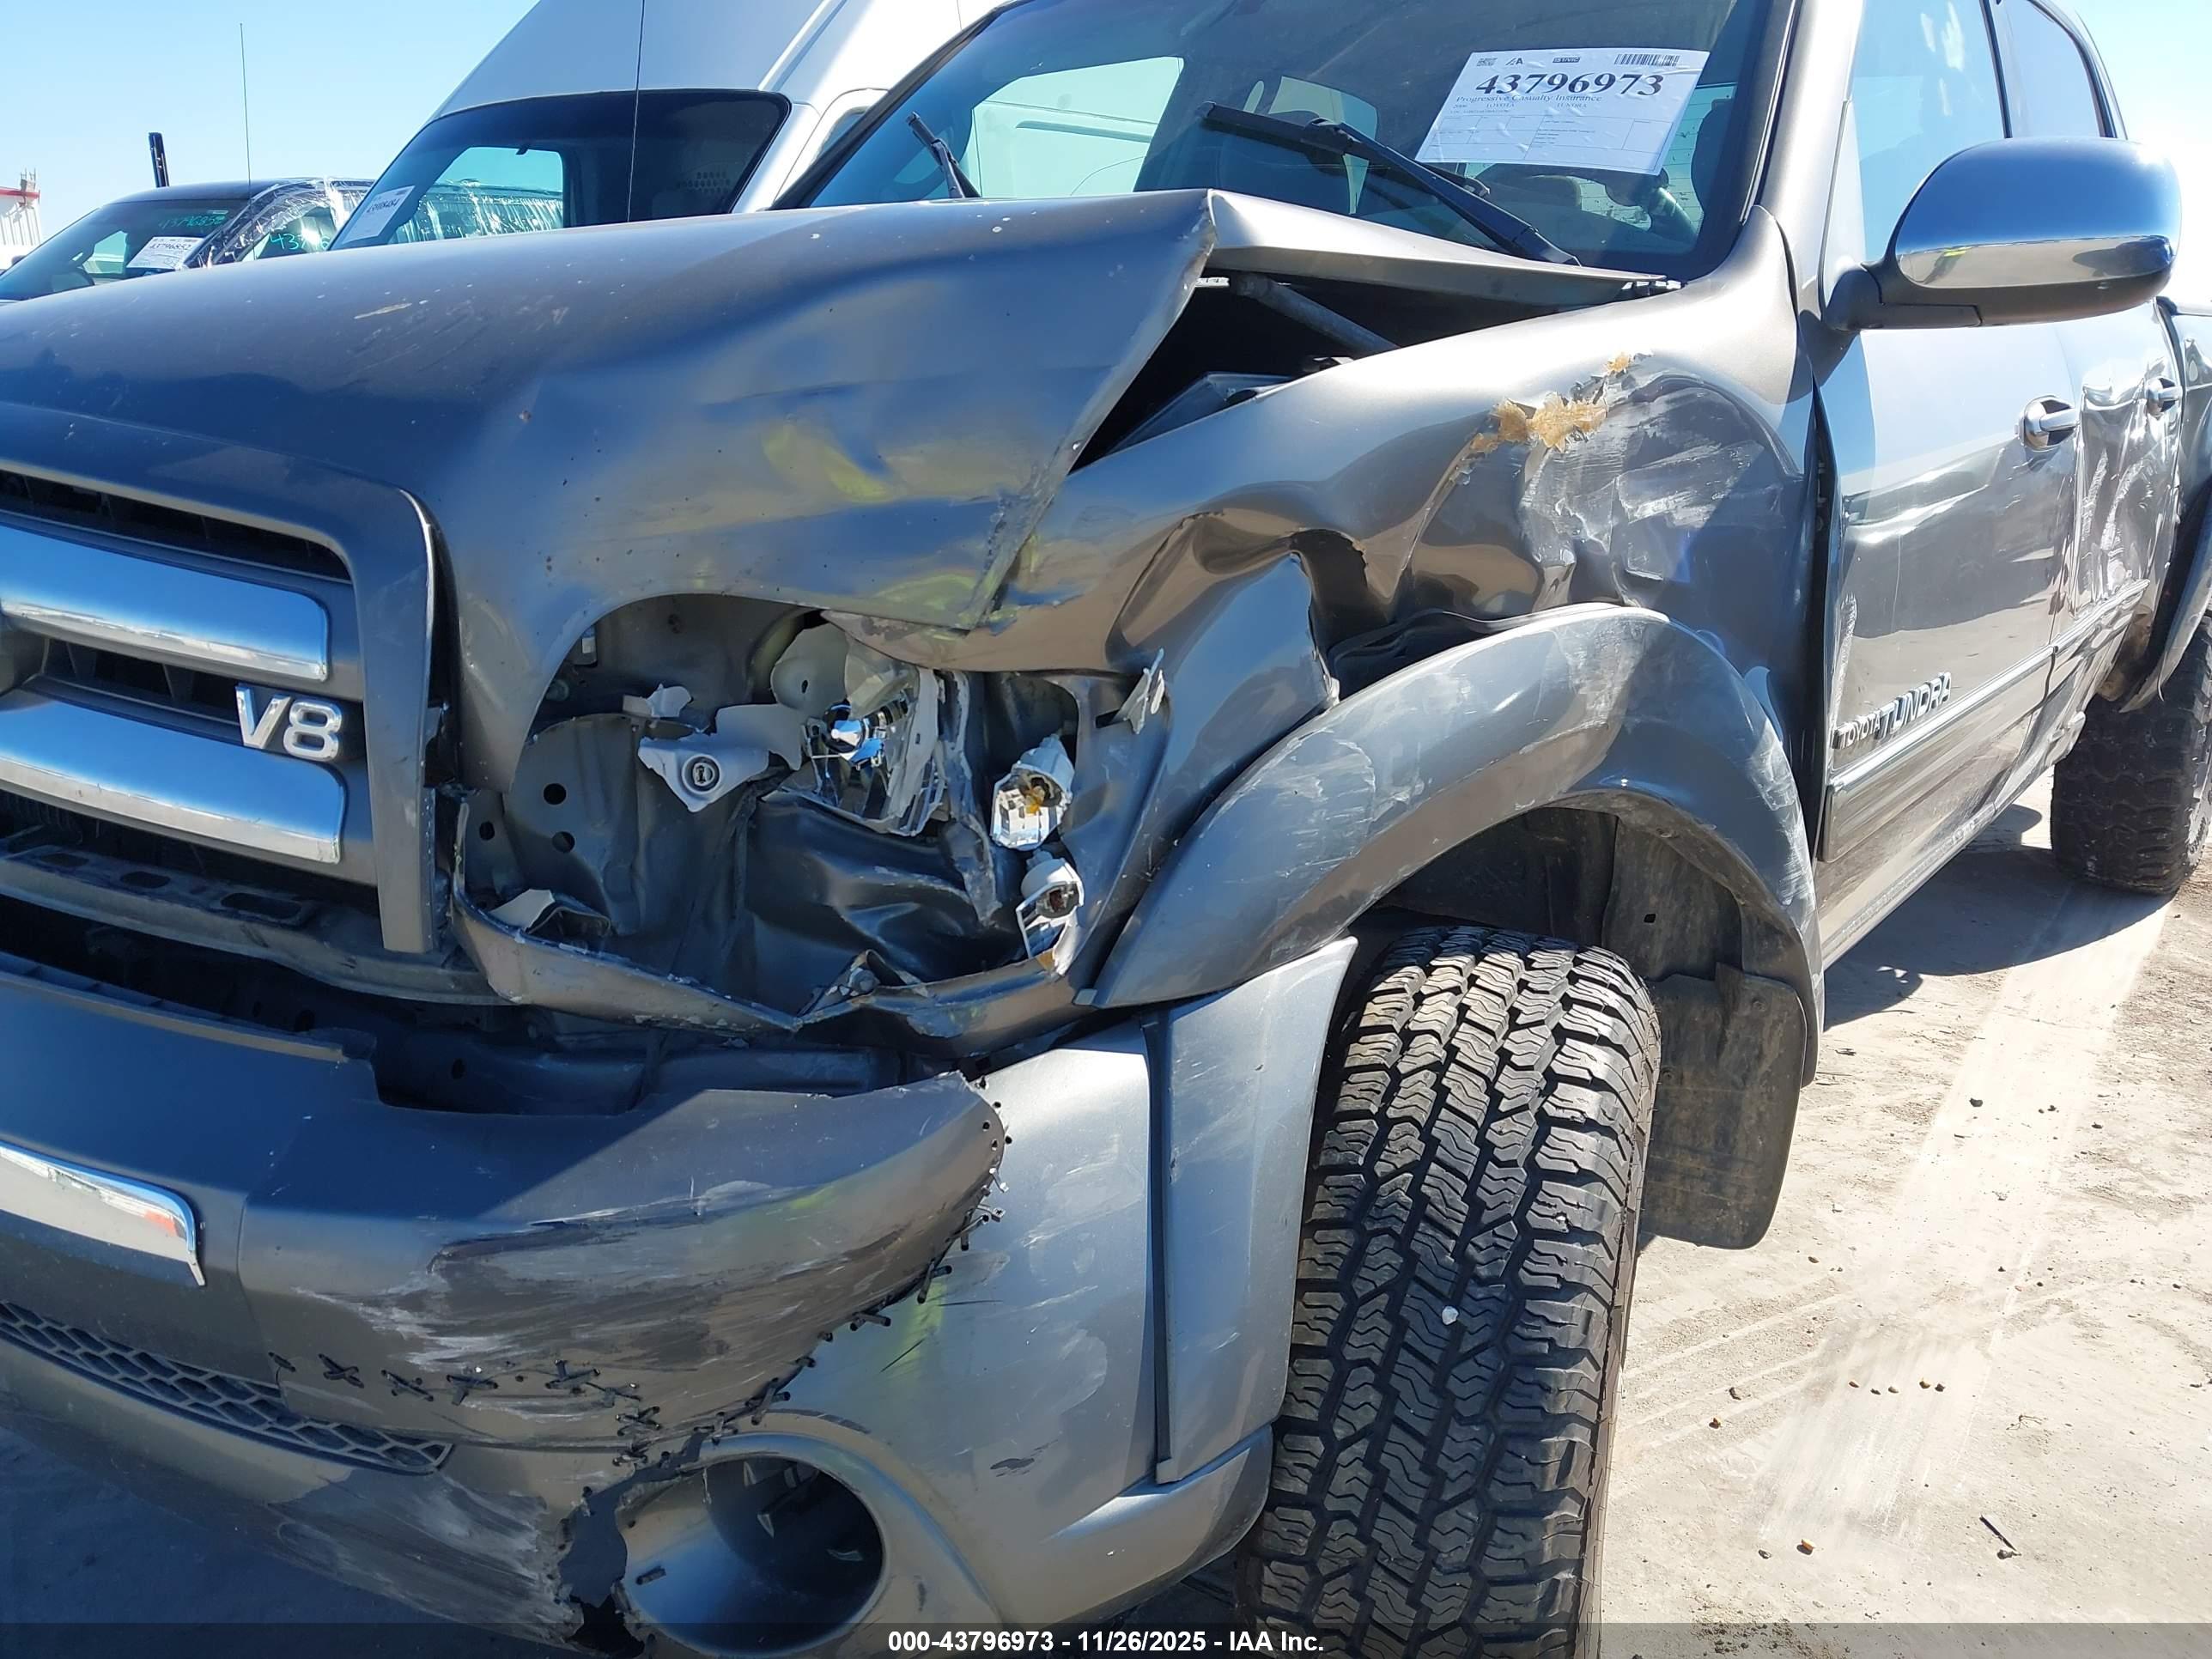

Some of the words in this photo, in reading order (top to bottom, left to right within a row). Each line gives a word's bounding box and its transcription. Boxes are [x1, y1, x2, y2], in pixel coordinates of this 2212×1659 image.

[1475, 72, 1664, 96] 43796973
[235, 683, 343, 763] V8
[1838, 709, 1881, 750] TOYOTA
[1877, 672, 1952, 739] TUNDRA
